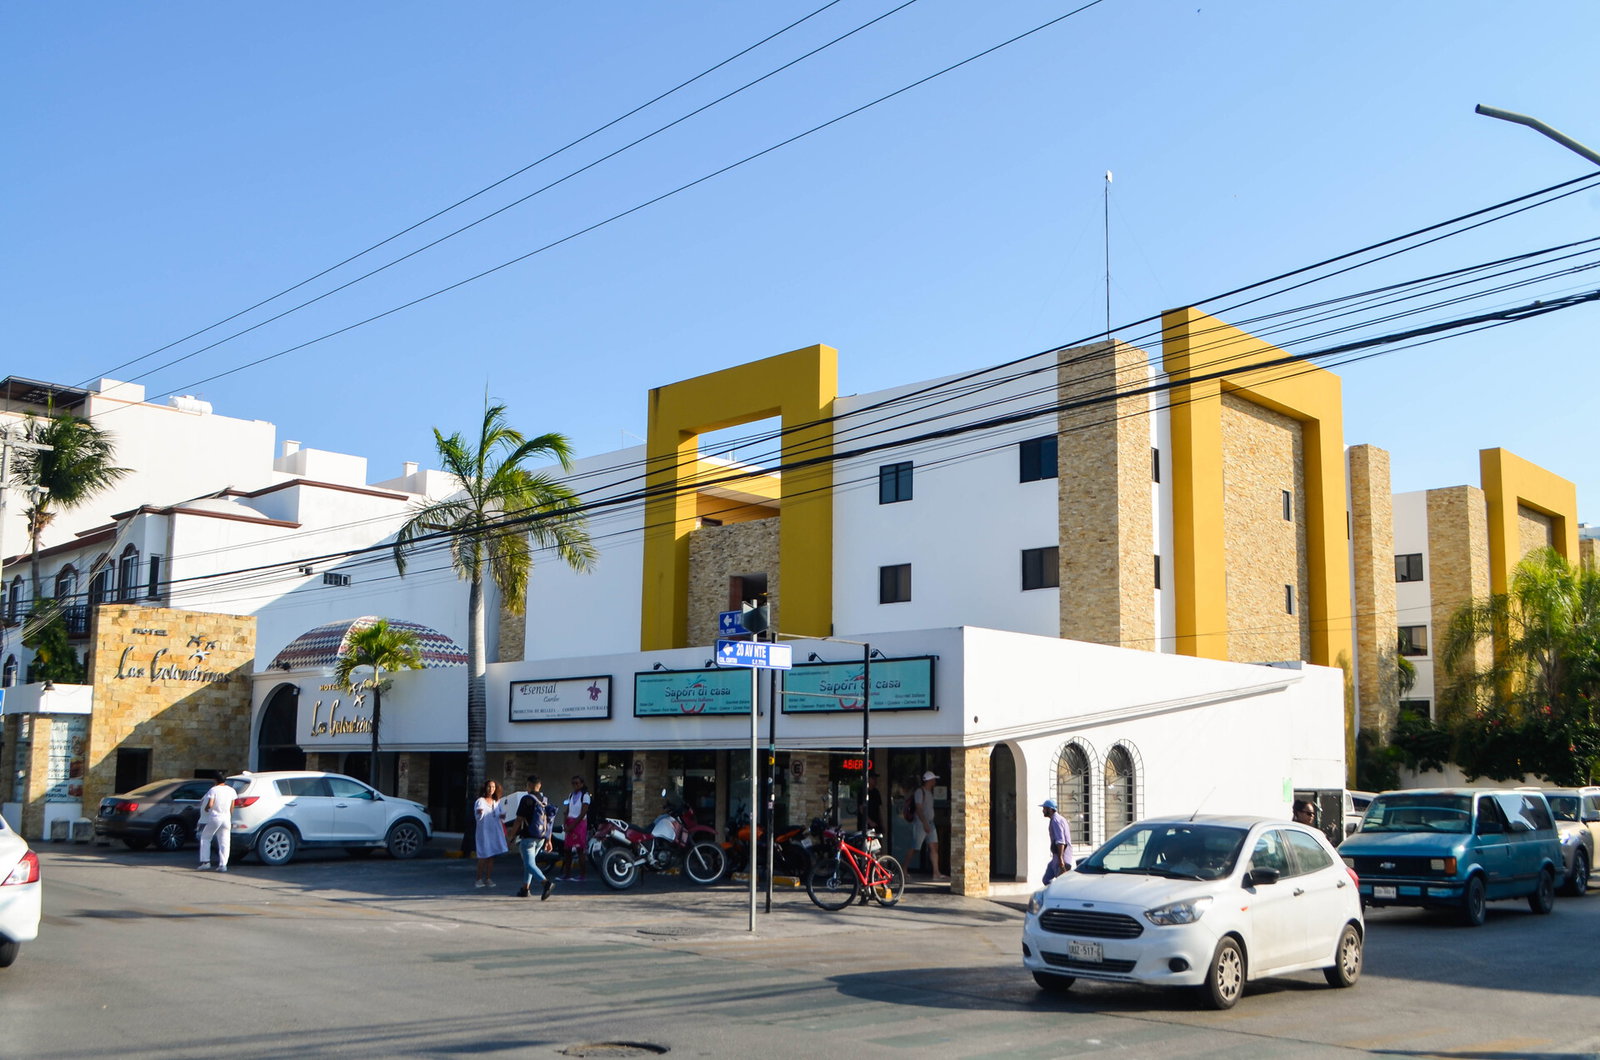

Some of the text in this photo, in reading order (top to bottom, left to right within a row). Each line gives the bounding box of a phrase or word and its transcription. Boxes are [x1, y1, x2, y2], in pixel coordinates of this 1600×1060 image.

[736, 643, 766, 658] 20 AV NTE
[114, 646, 231, 682] Las Golondrinas
[665, 684, 731, 700] Sapori di casa
[820, 680, 857, 695] Sapori
[875, 680, 901, 689] casa
[843, 760, 873, 770] ABIERO
